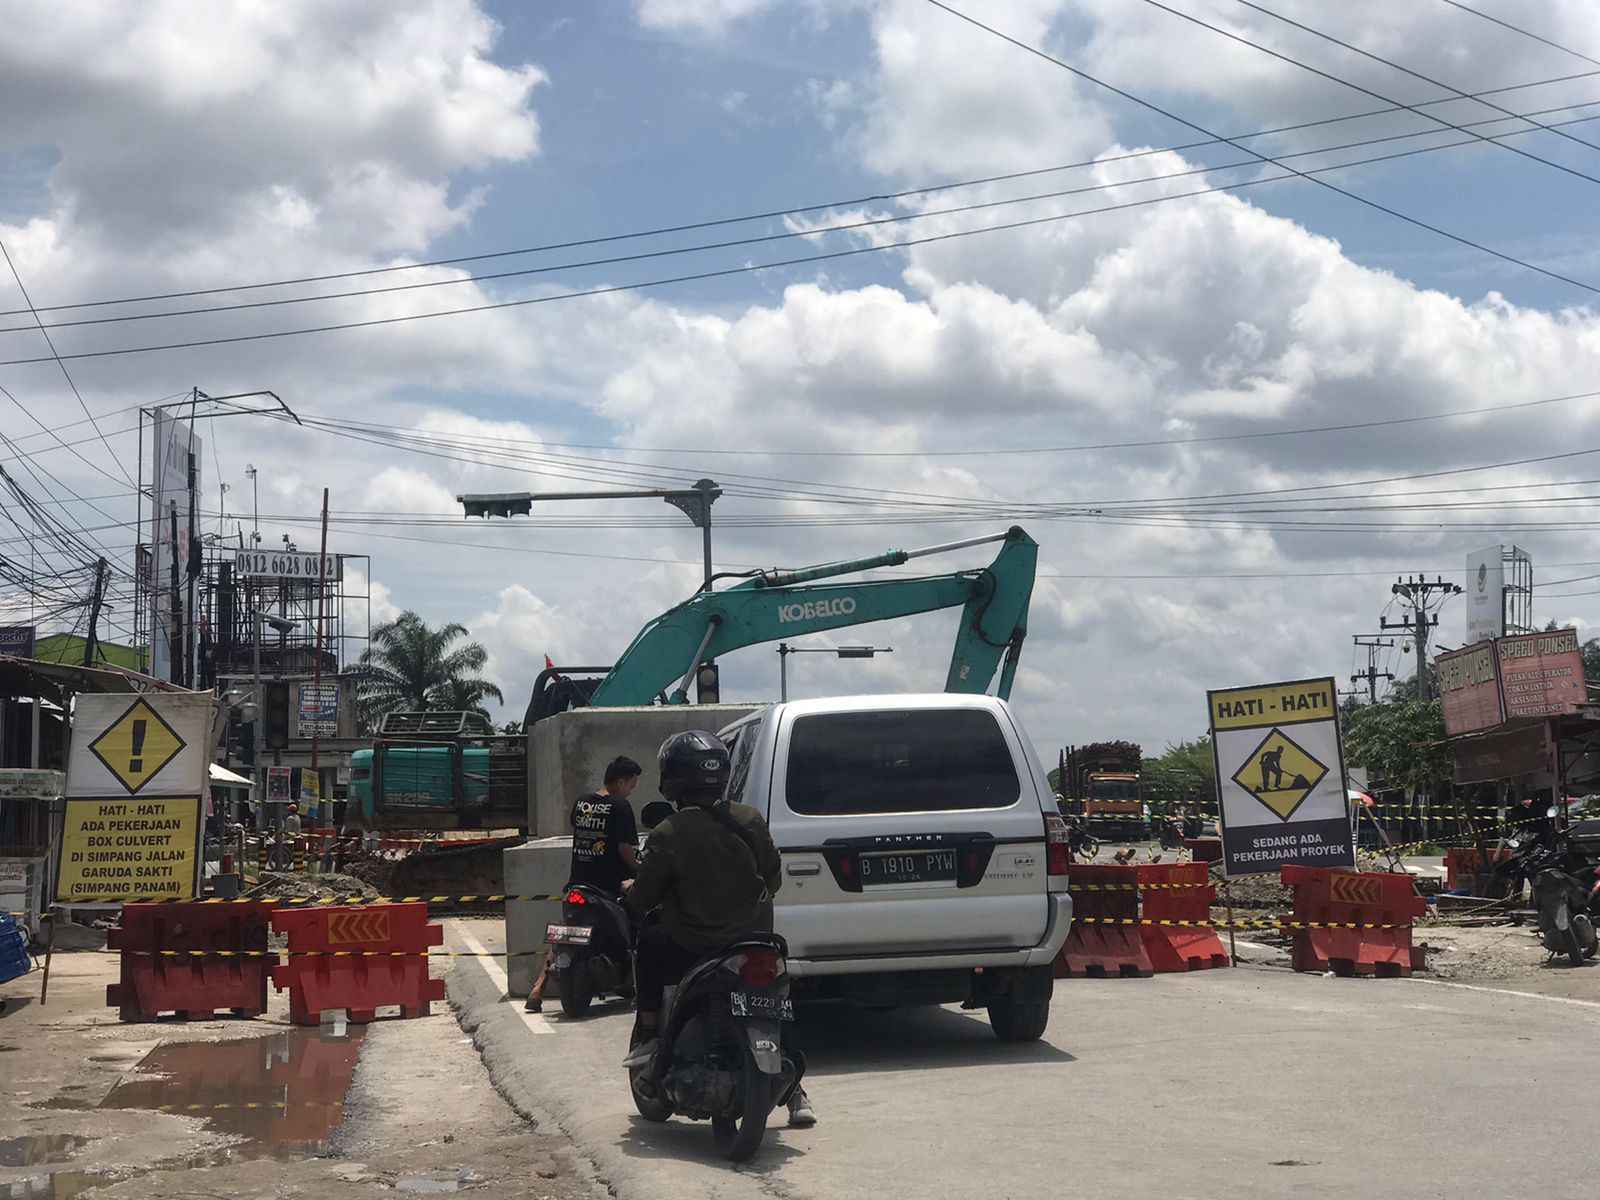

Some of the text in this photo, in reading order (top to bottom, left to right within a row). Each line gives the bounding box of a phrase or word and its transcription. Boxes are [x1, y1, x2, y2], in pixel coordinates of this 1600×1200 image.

[238, 553, 333, 576] 0812 6628 082
[778, 597, 856, 623] KOBELCO
[1501, 634, 1579, 660] SPEED PONSEL
[1218, 699, 1264, 718] HATI
[1282, 691, 1328, 711] HATI
[99, 805, 127, 816] HATI
[137, 804, 165, 815] HATI
[576, 800, 613, 815] HOUSE
[80, 820, 181, 832] ADA PEKERJAAN
[575, 815, 606, 830] SMITH
[88, 835, 172, 847] BOX CULVERT
[1252, 834, 1323, 848] SEDANG ADA
[71, 851, 185, 862] DI SIMPANG JALAN
[1233, 845, 1345, 862] PEKERJAAN PROYEK
[81, 866, 173, 878] GARUDA SAKTI
[862, 854, 953, 875] B 1910 PYW
[70, 881, 181, 895] (SIMPANG PANAM)
